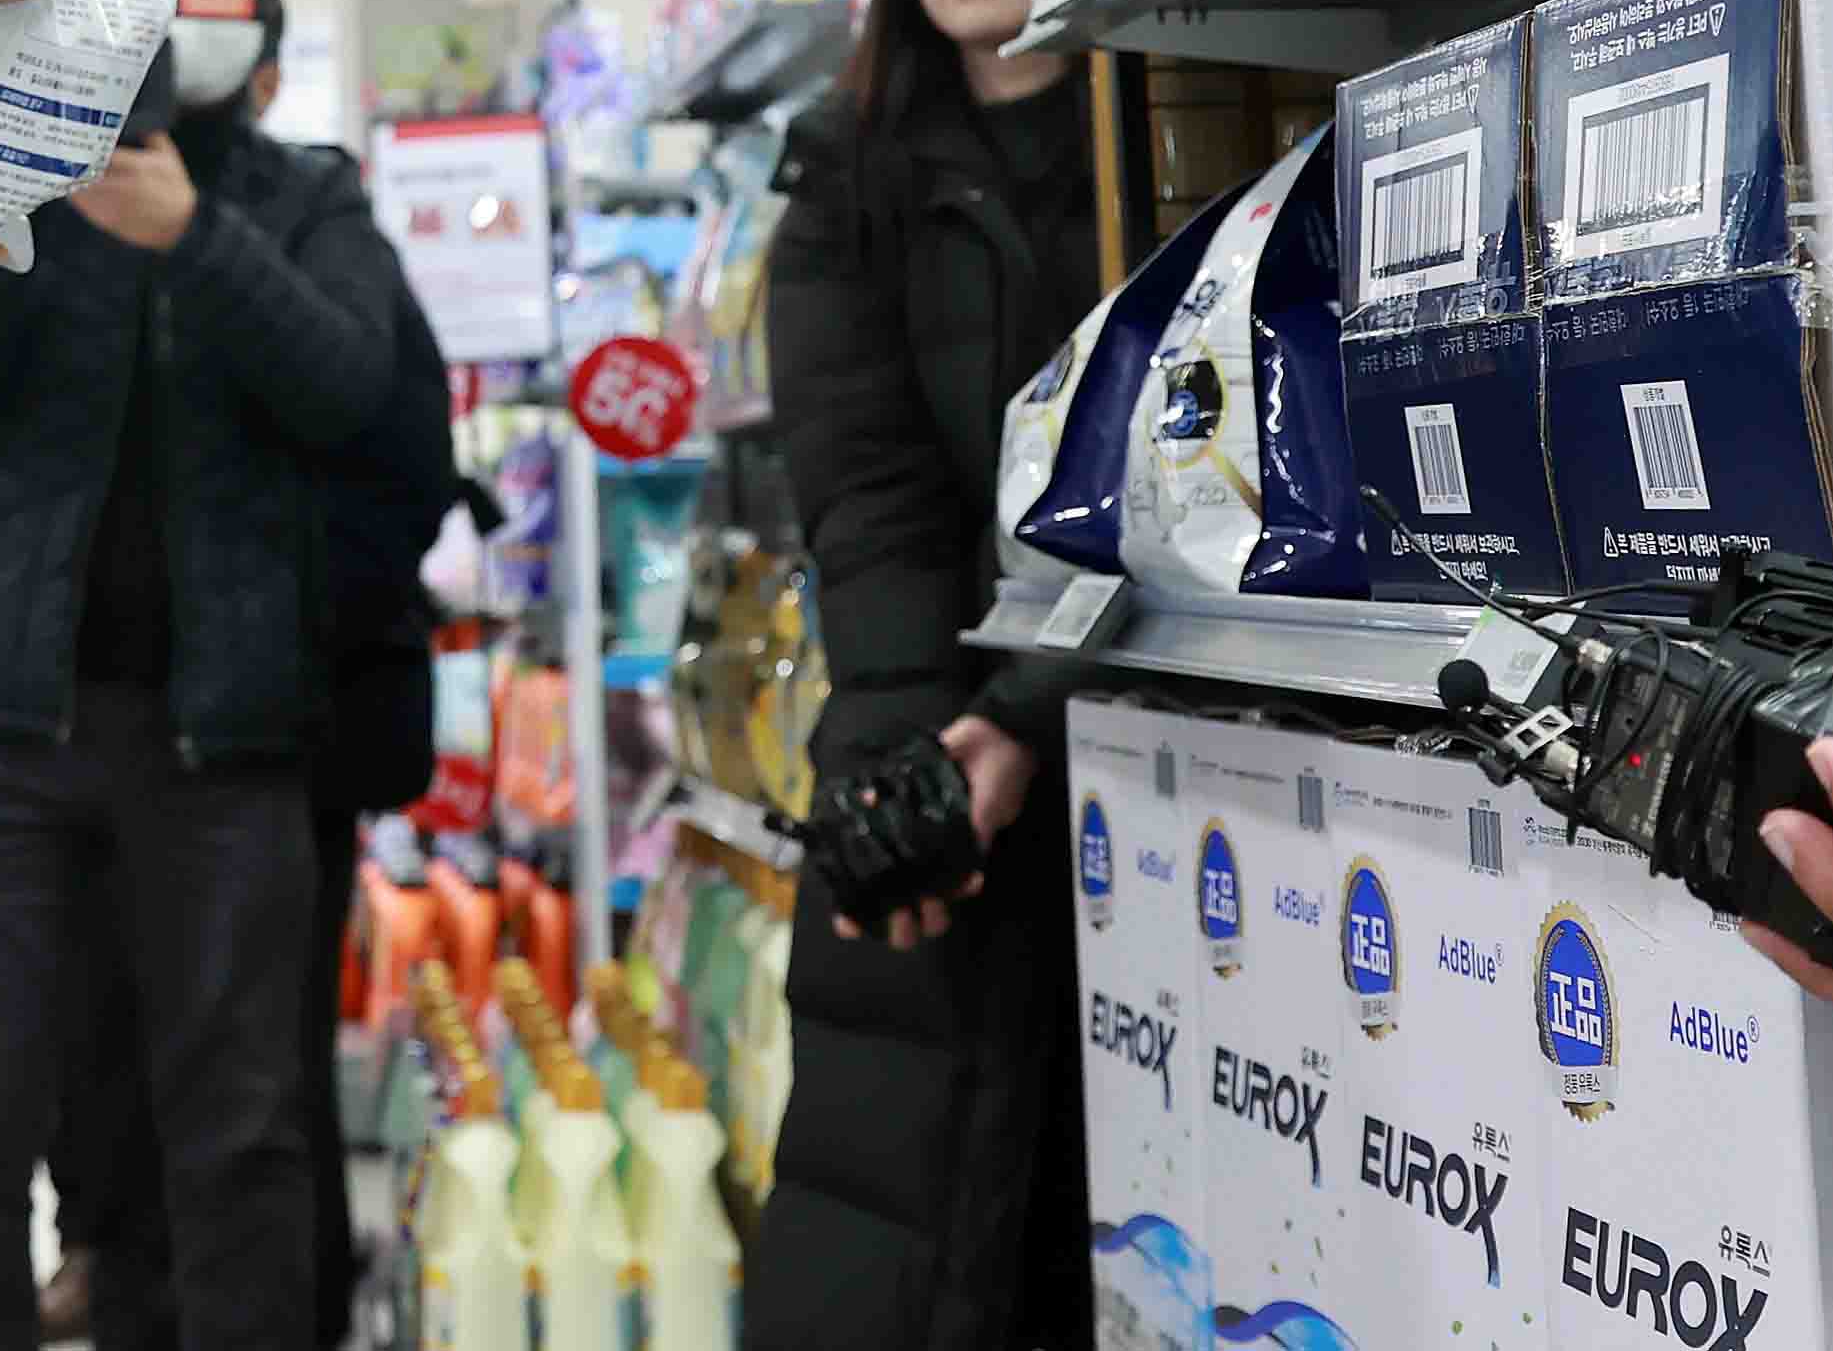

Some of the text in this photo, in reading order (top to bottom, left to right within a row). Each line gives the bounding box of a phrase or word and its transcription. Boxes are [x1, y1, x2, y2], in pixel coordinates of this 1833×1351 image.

[1686, 10, 1708, 38] PET
[1481, 323, 1526, 353] 대한민국
[1628, 532, 1658, 556] 제품을
[1657, 533, 1689, 556] 반드시
[1689, 533, 1720, 557] 세워서
[1351, 912, 1392, 978] 正品
[1549, 970, 1604, 1048] 正品
[1090, 989, 1178, 1112] EUROX
[1213, 1045, 1329, 1188] EUROX
[1472, 1121, 1511, 1163] 유록스
[1360, 1114, 1510, 1289] EUROX
[1561, 1205, 1769, 1351] EUROX
[1717, 1224, 1773, 1278] 유록스
